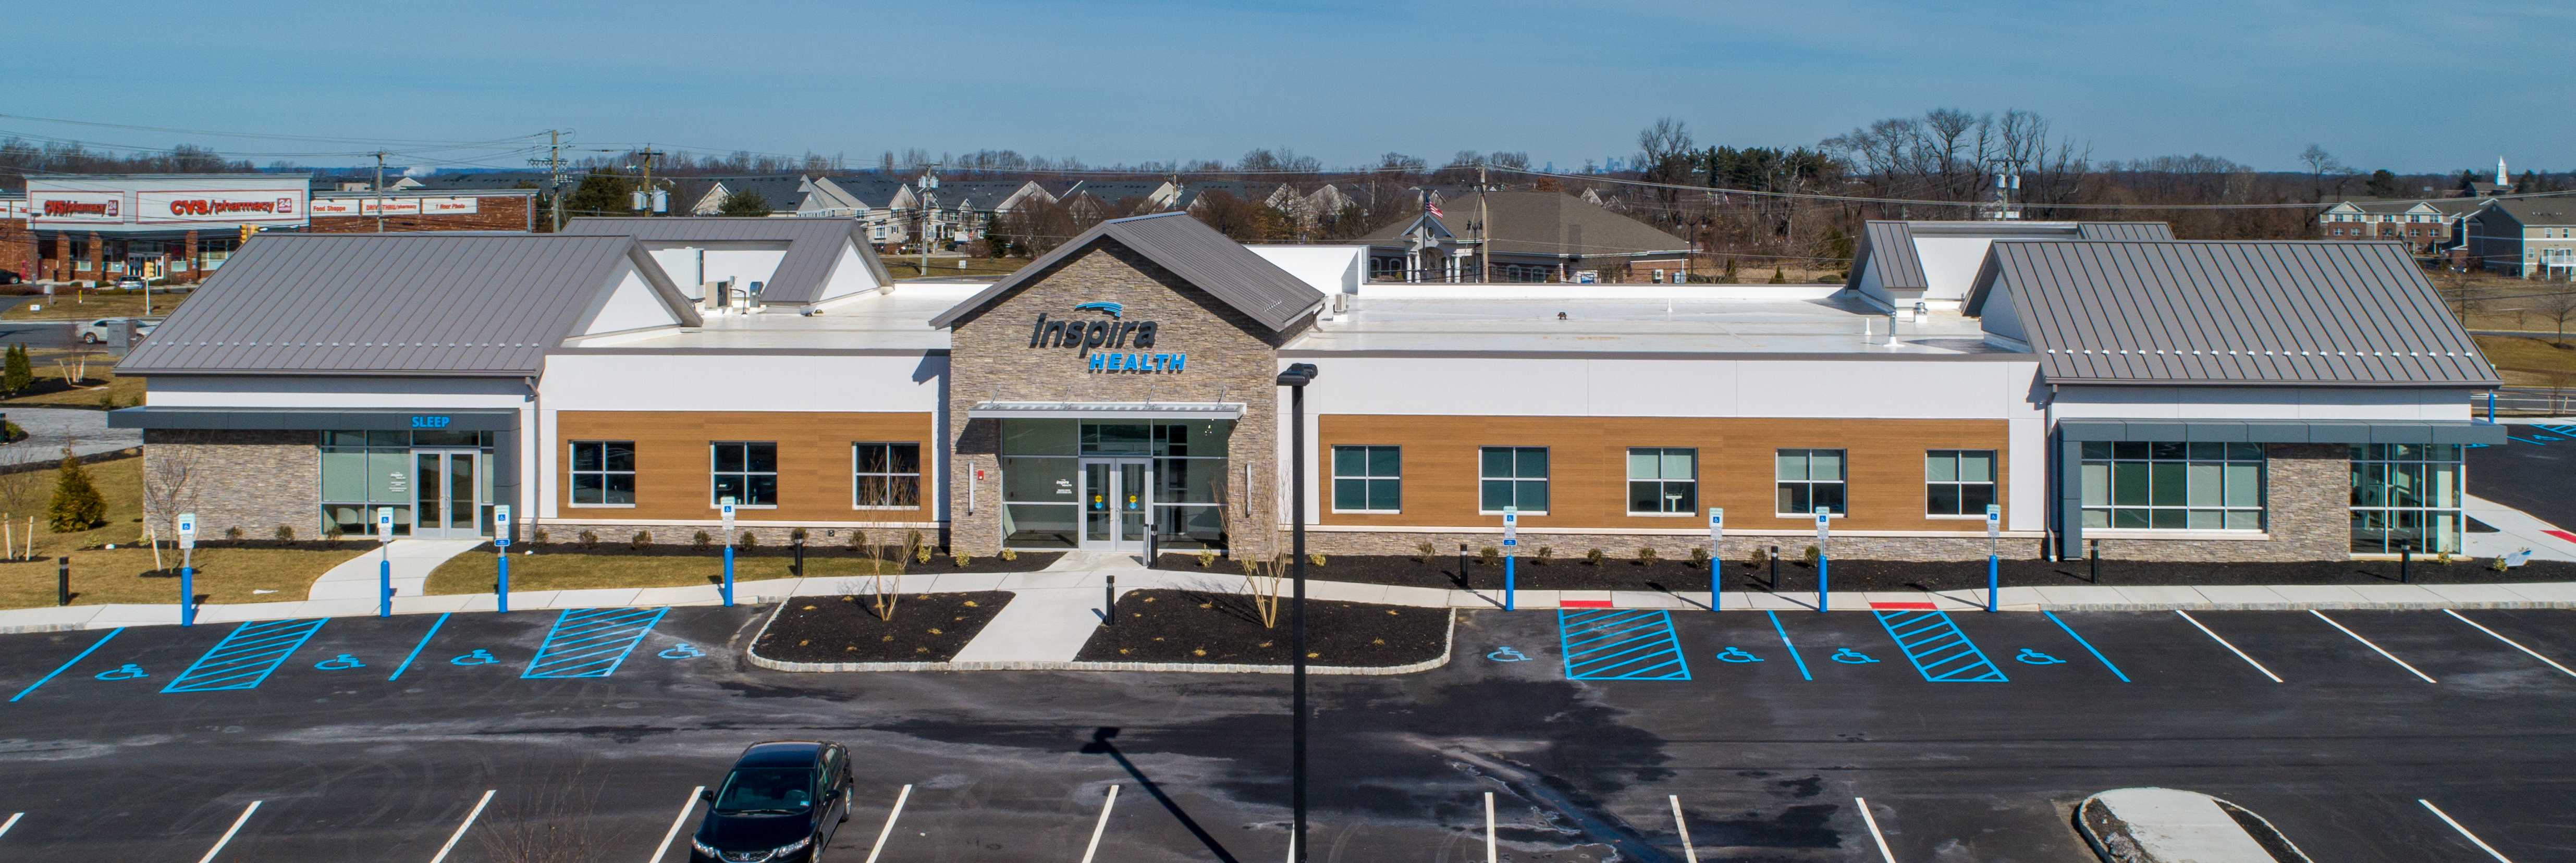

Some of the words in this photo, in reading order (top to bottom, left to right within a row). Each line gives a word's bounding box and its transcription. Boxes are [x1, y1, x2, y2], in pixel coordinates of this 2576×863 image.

[108, 201, 117, 209] 24
[170, 200, 275, 215] CVS/pharmacy
[1089, 353, 1186, 372] HEALTH
[411, 415, 450, 428] SLEEP
